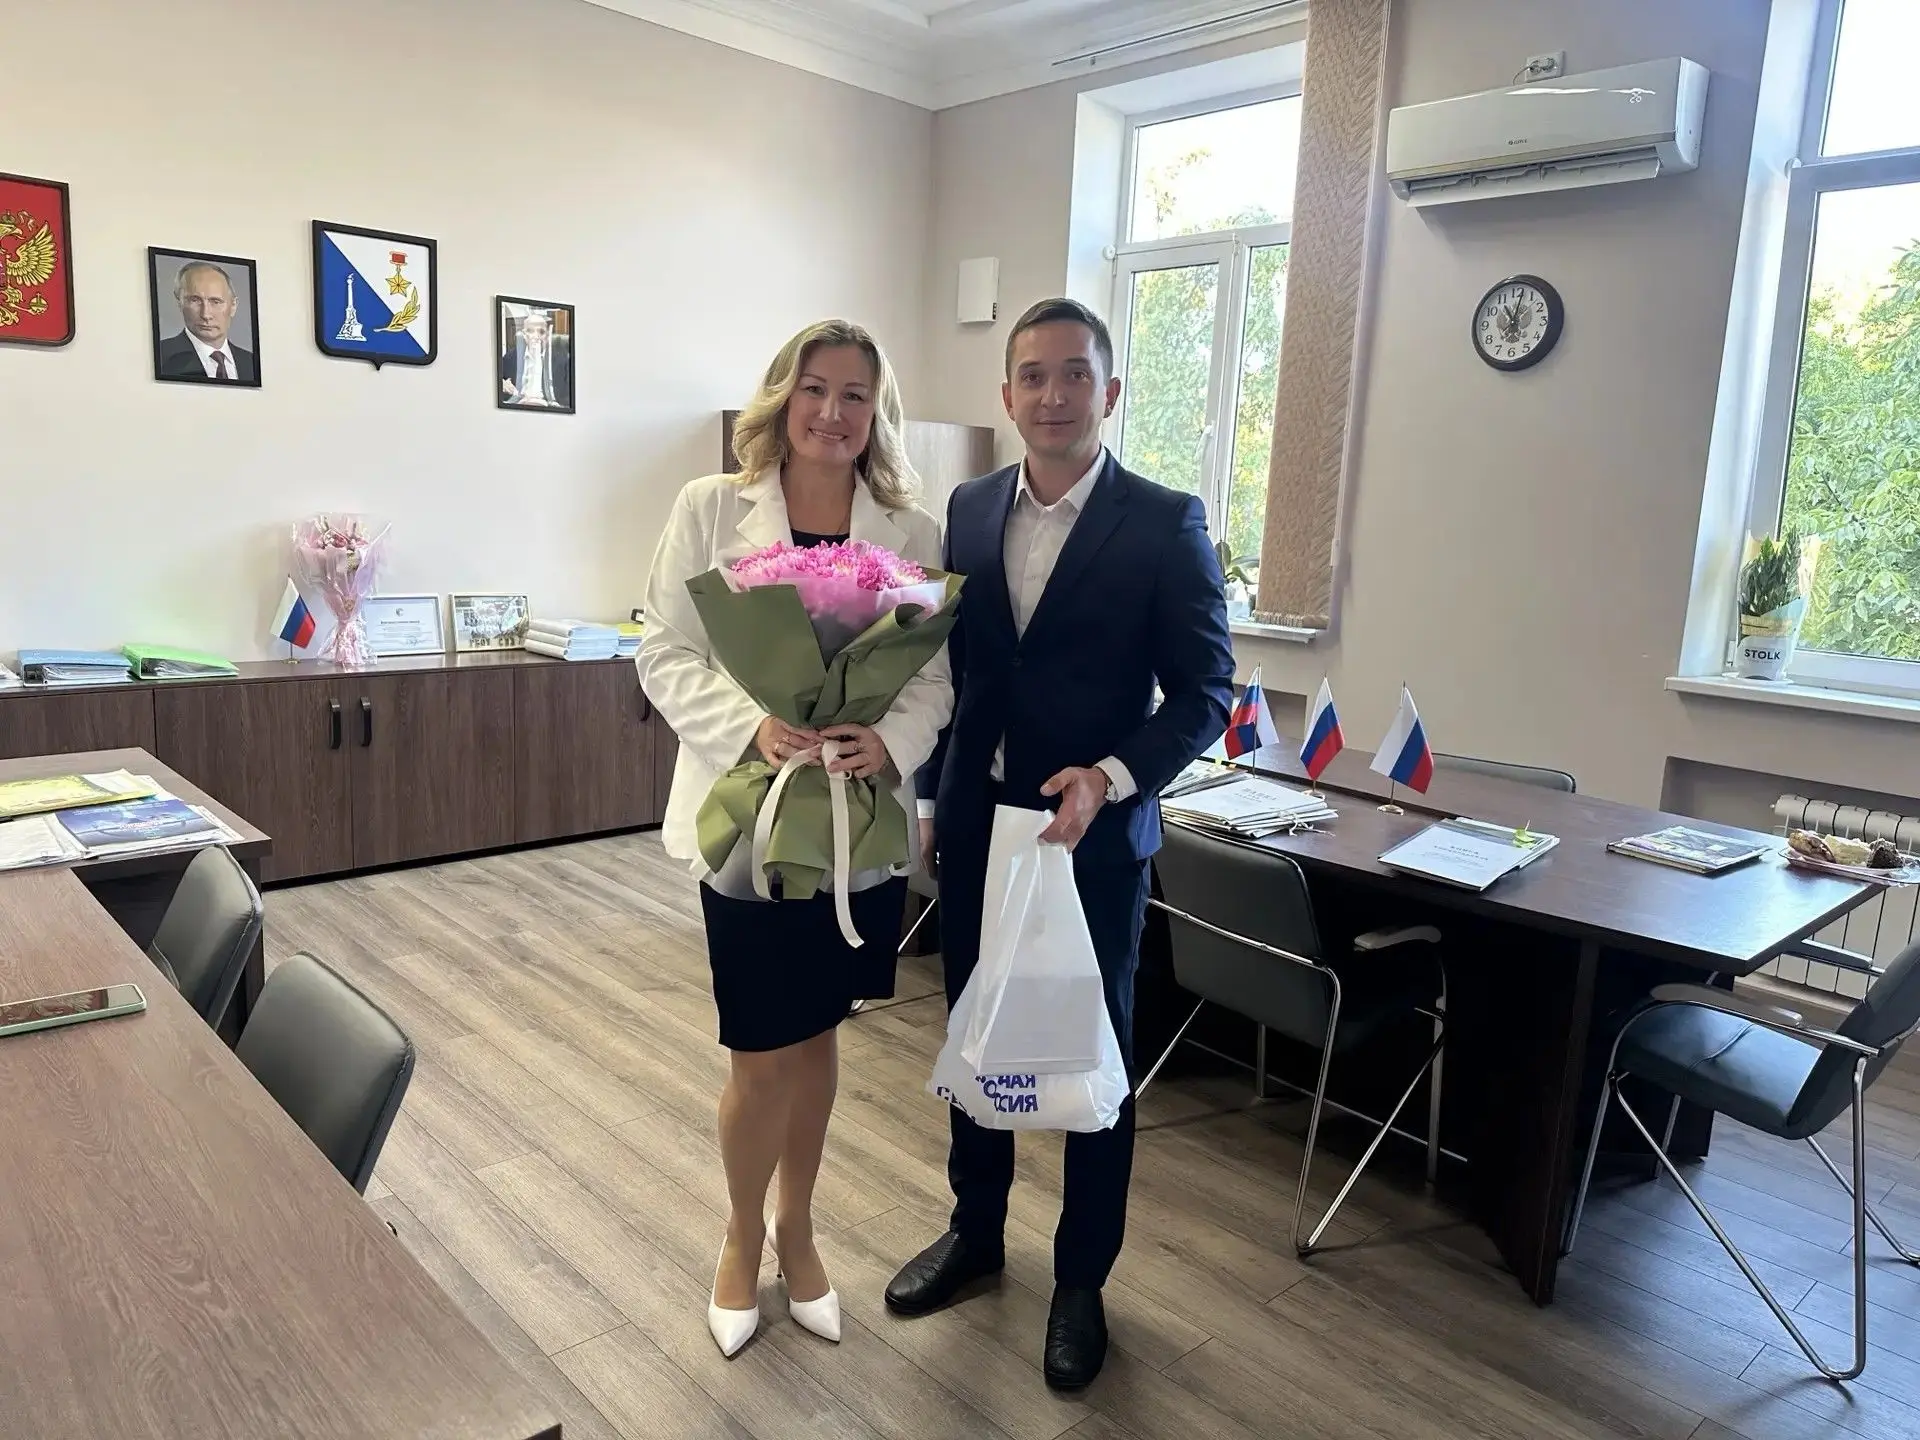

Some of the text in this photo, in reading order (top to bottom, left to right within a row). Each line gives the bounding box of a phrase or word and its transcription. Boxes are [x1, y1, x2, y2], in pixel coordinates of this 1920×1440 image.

[1512, 288, 1524, 298] 12
[1530, 292, 1534, 301] 1
[1498, 294, 1506, 304] 11
[1487, 306, 1497, 316] 10
[1536, 303, 1543, 312] 2
[1482, 320, 1490, 331] 9
[1540, 316, 1548, 326] 3
[1486, 335, 1493, 344] 8
[1533, 331, 1541, 341] 4
[1495, 345, 1502, 355] 7
[1508, 348, 1516, 358] 6
[1522, 344, 1530, 353] 5
[1744, 648, 1780, 660] STOLK
[998, 1074, 1036, 1089] НАЯ
[976, 1076, 1038, 1112] ОССИЯ
